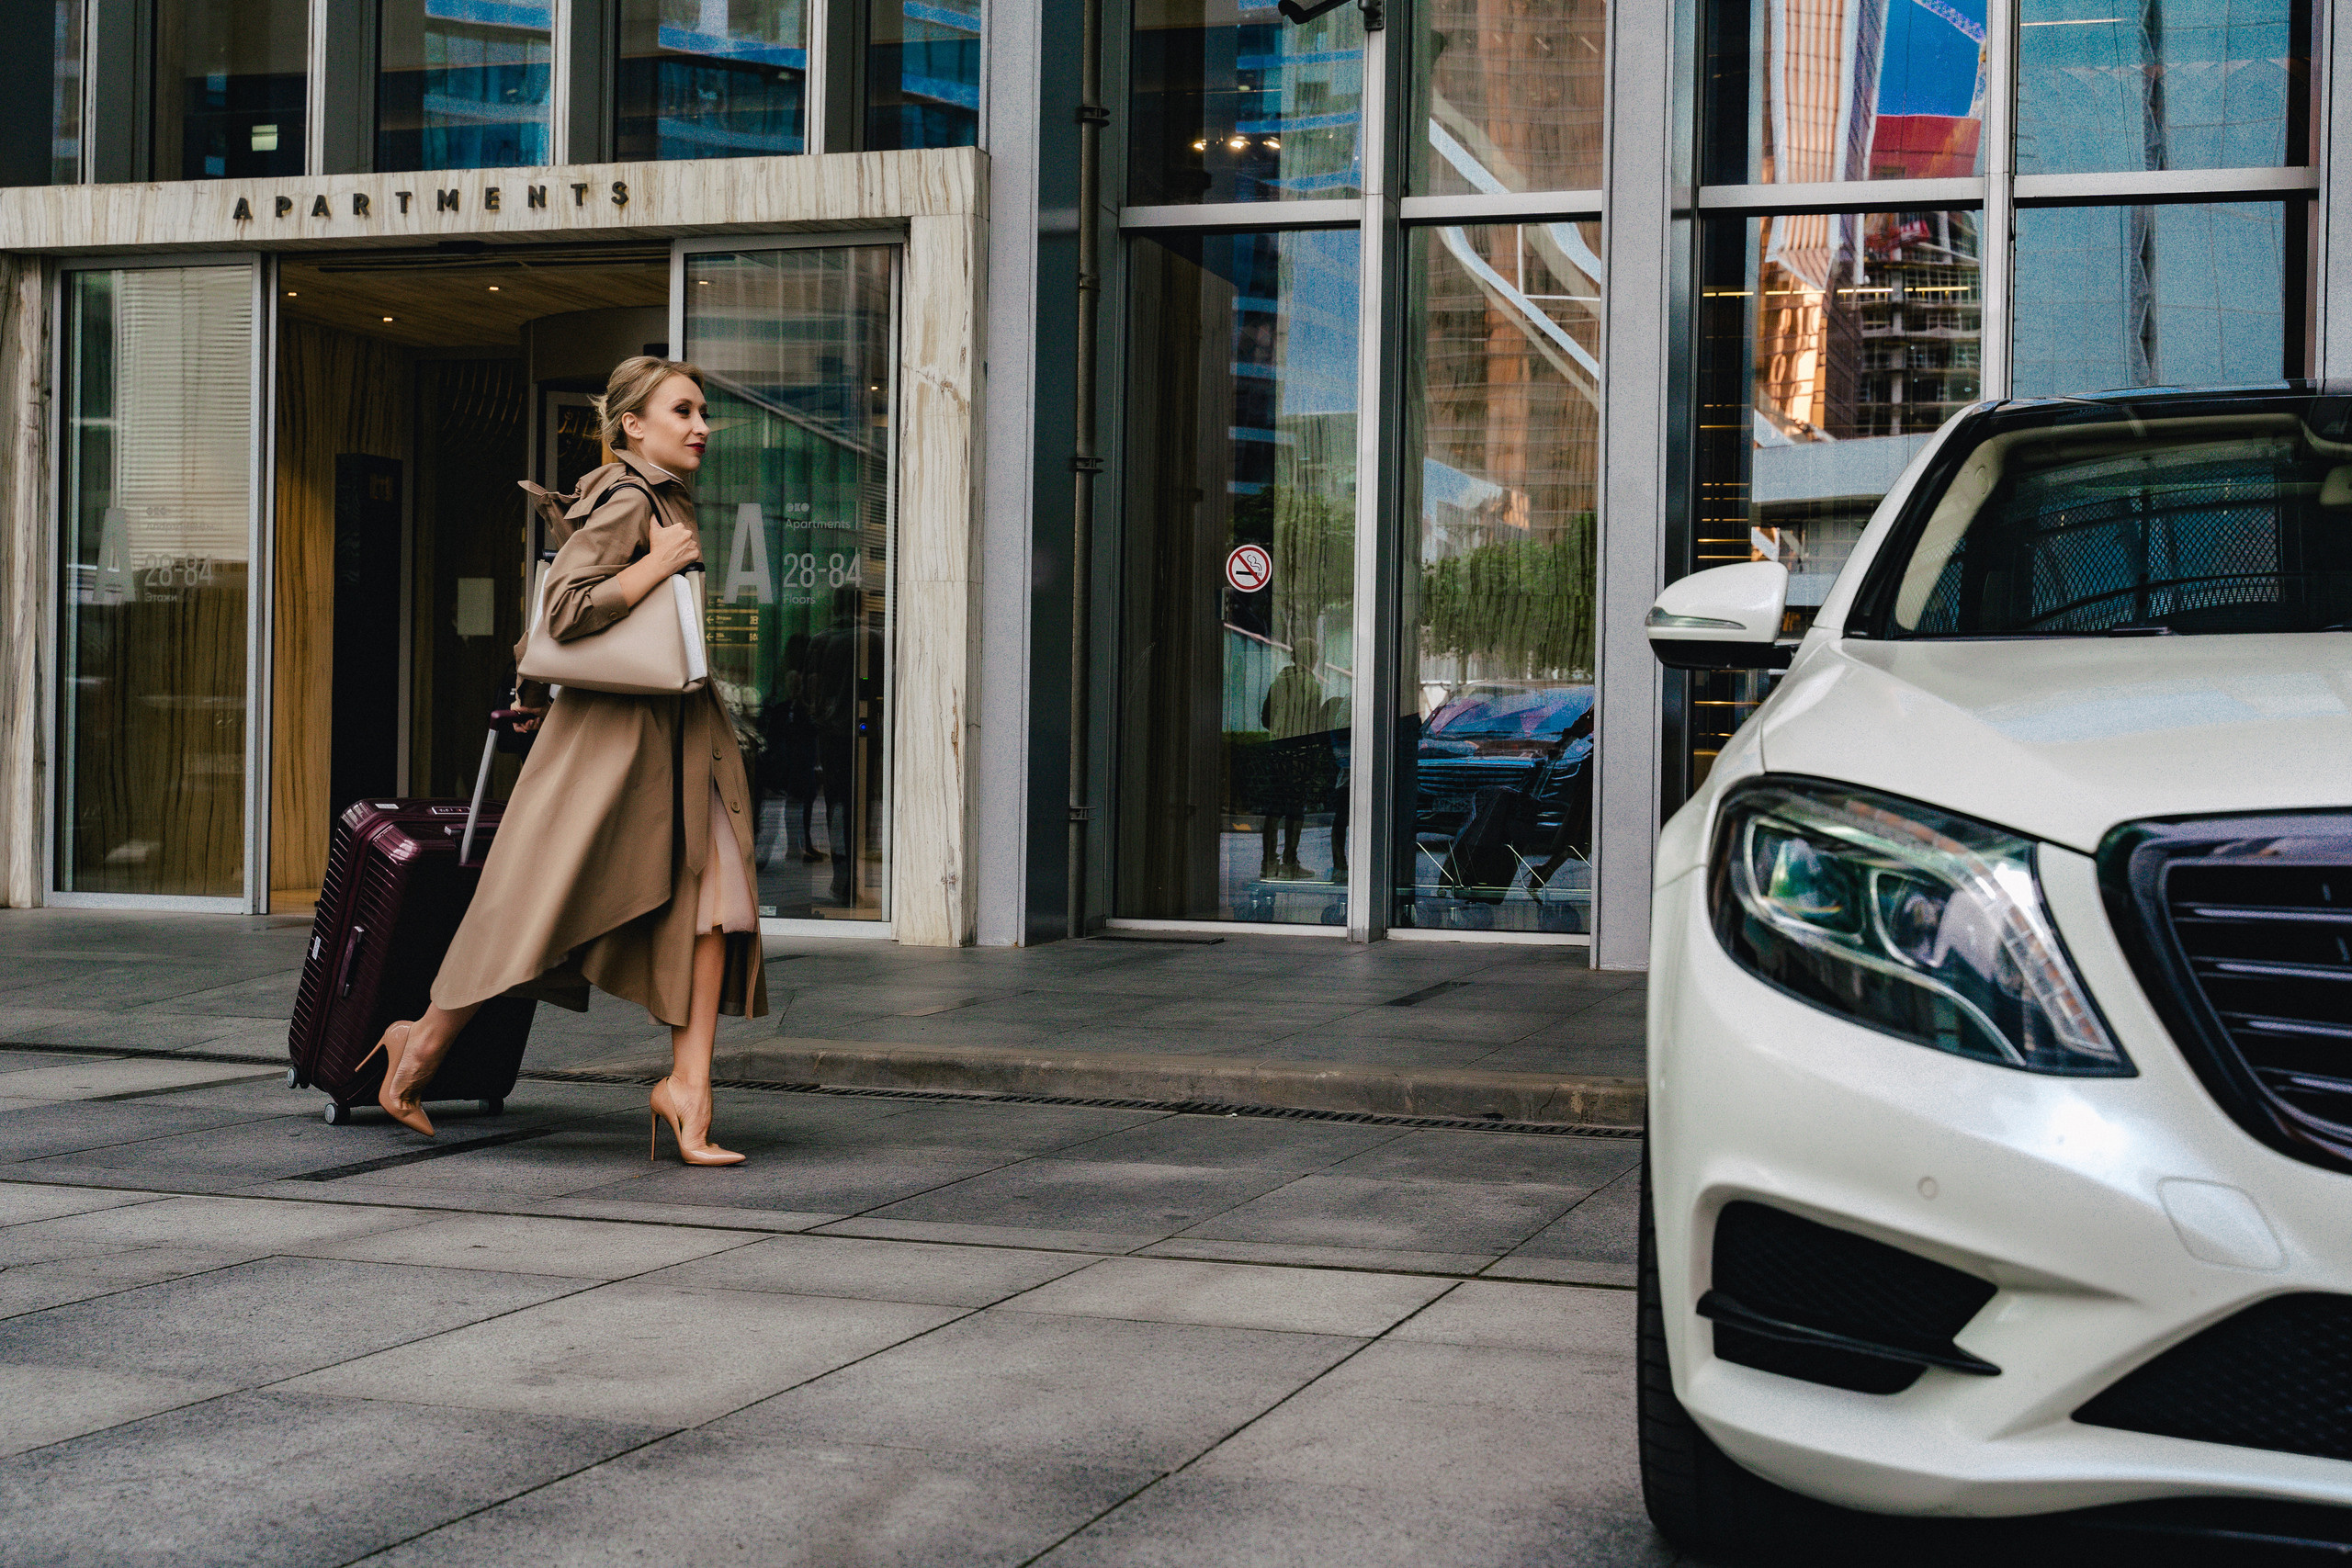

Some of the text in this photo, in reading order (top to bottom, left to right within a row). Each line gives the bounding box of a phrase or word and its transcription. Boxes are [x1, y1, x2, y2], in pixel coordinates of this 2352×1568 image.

[233, 180, 630, 220] APARTMENTS
[786, 518, 851, 531] Apartments
[144, 553, 214, 587] 28-84
[723, 503, 774, 604] A
[783, 553, 862, 588] 28-84
[784, 596, 817, 604] Floors
